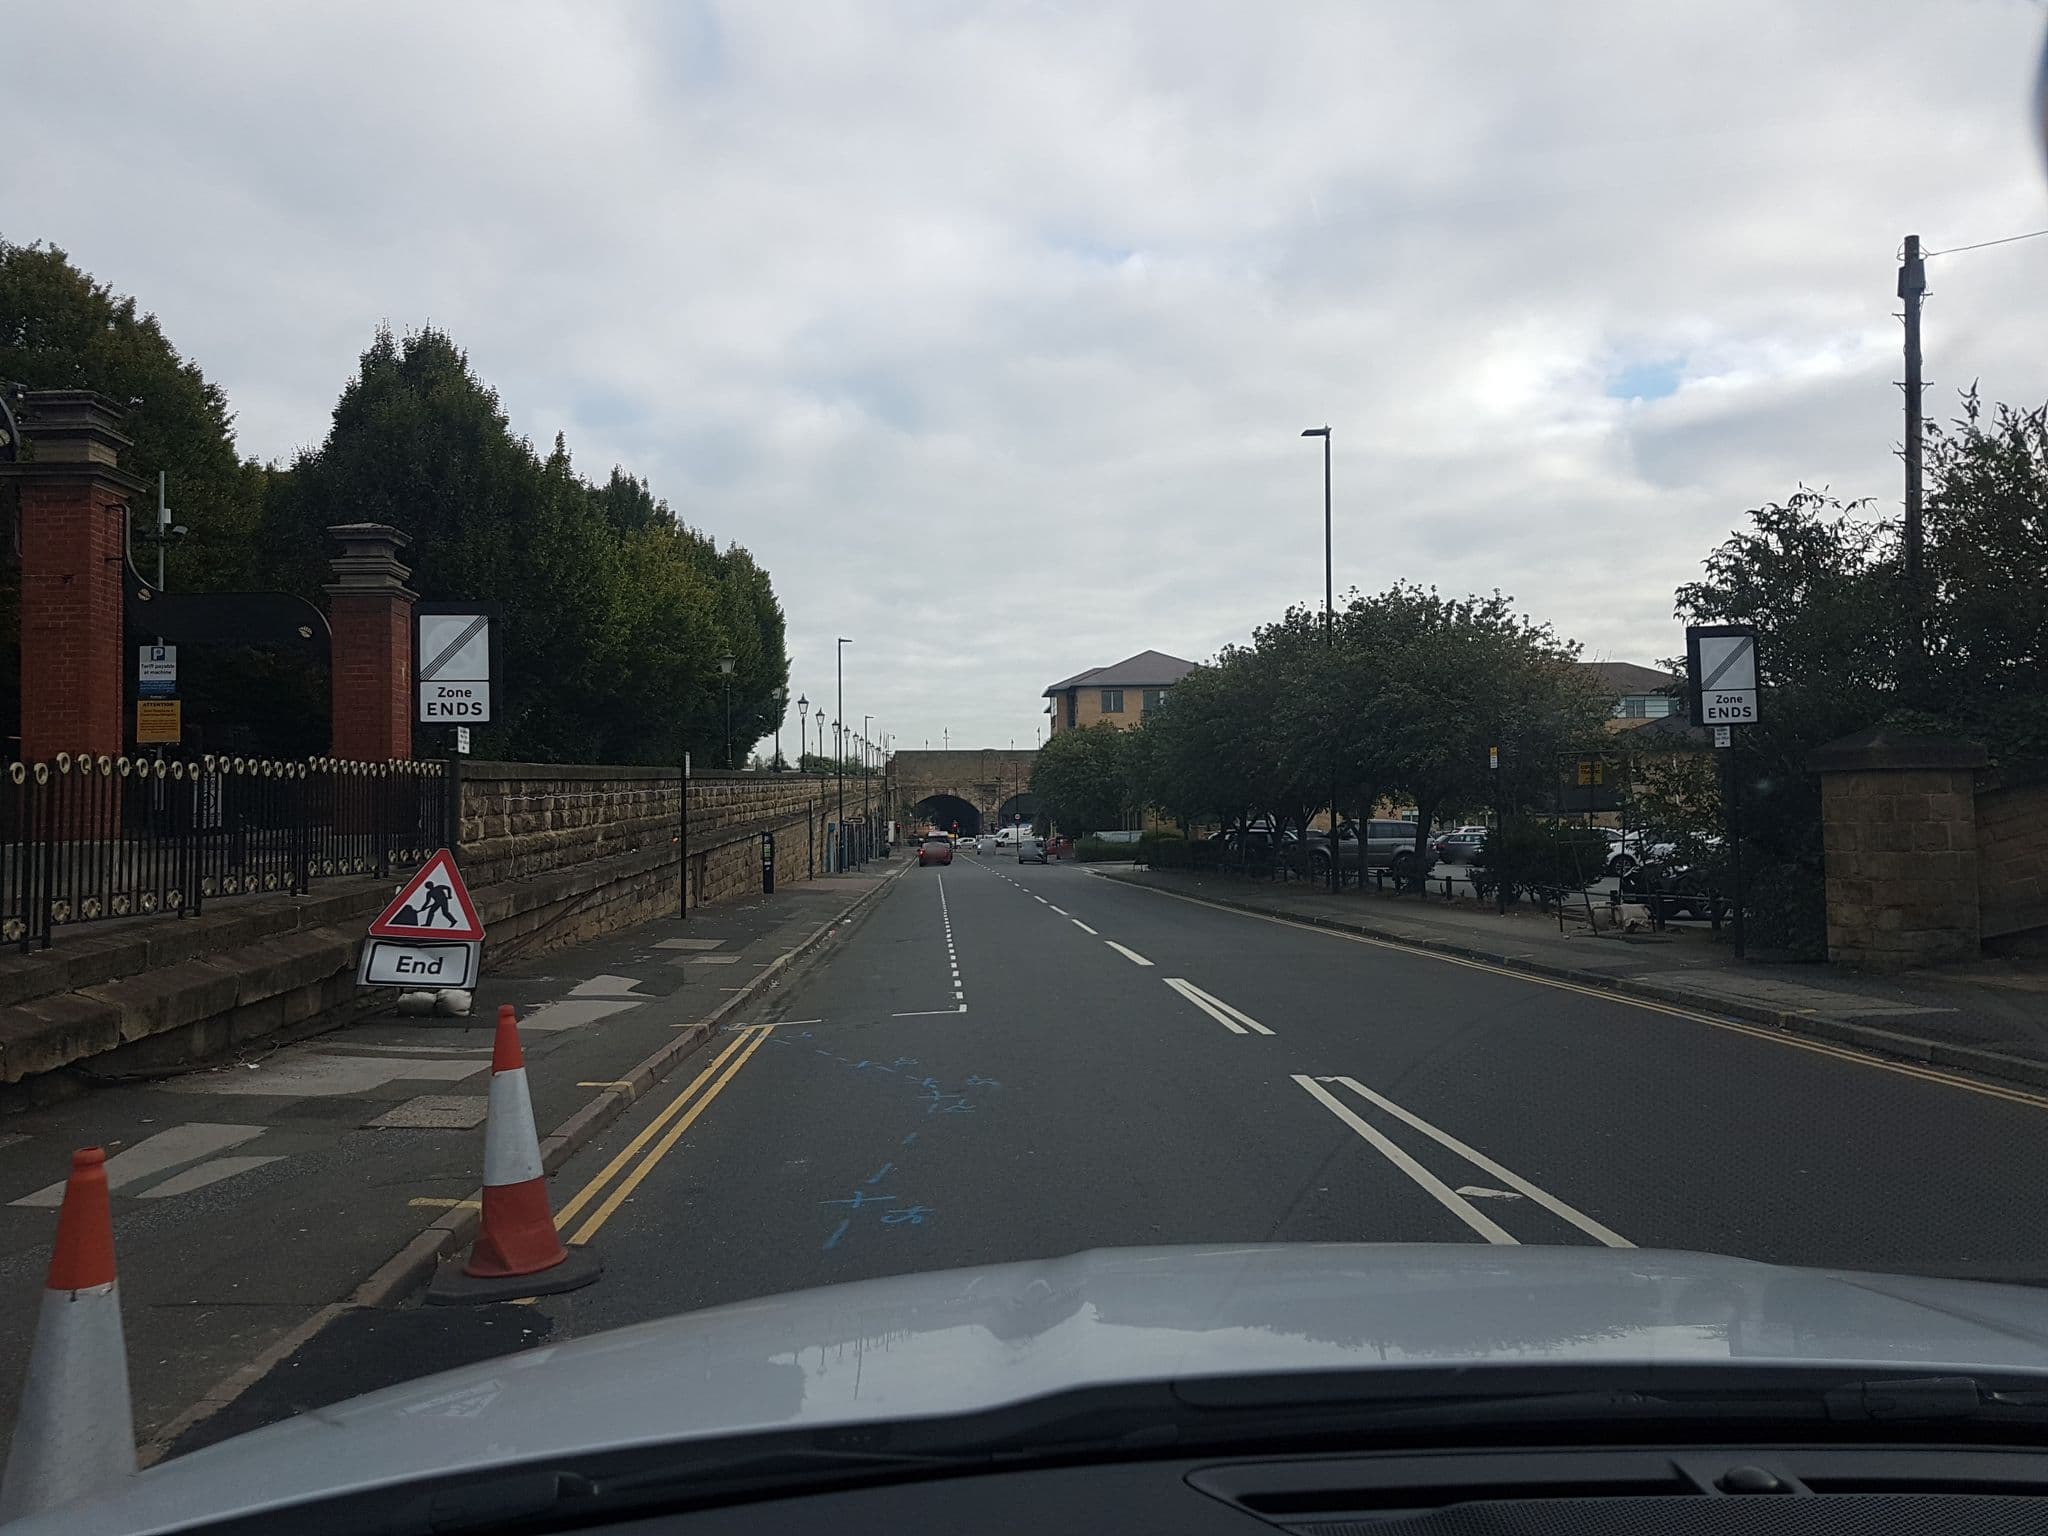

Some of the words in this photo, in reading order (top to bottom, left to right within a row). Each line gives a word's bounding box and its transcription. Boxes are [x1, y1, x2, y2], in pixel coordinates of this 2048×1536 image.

[153, 648, 164, 660] P
[437, 686, 472, 698] Zone
[1716, 695, 1743, 704] Zone
[427, 702, 482, 716] ENDS
[1708, 706, 1752, 718] ENDS
[395, 955, 443, 975] End
